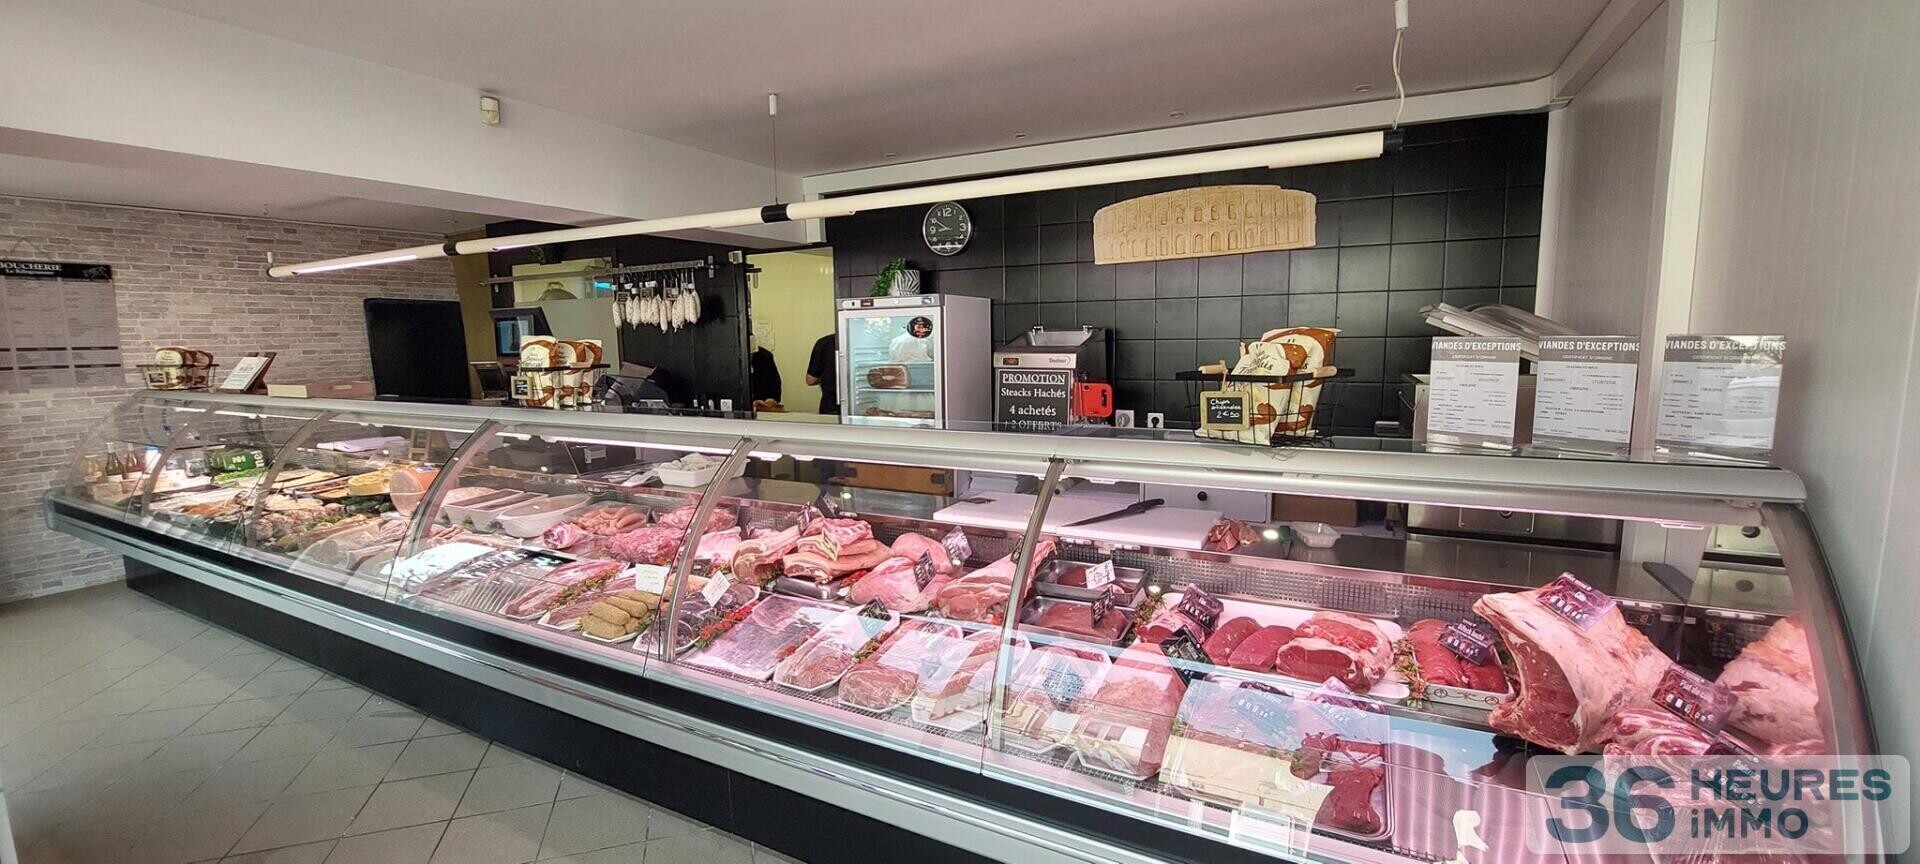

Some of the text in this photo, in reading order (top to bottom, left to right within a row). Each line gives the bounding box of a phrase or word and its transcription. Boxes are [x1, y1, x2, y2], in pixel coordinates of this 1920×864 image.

[942, 208, 952, 216] 12
[930, 226, 936, 234] 9
[960, 222, 966, 232] 3
[1464, 342, 1521, 351] D'EXCEPTIONS
[1538, 341, 1640, 352] VIANDES D'EXCEPTIONS
[1665, 340, 1706, 350] VIANDES
[1002, 373, 1066, 384] PROMOTION
[1001, 387, 1066, 398] Steacks Hachés
[1210, 398, 1231, 406] Chips
[1009, 405, 1057, 416] 4 achetés
